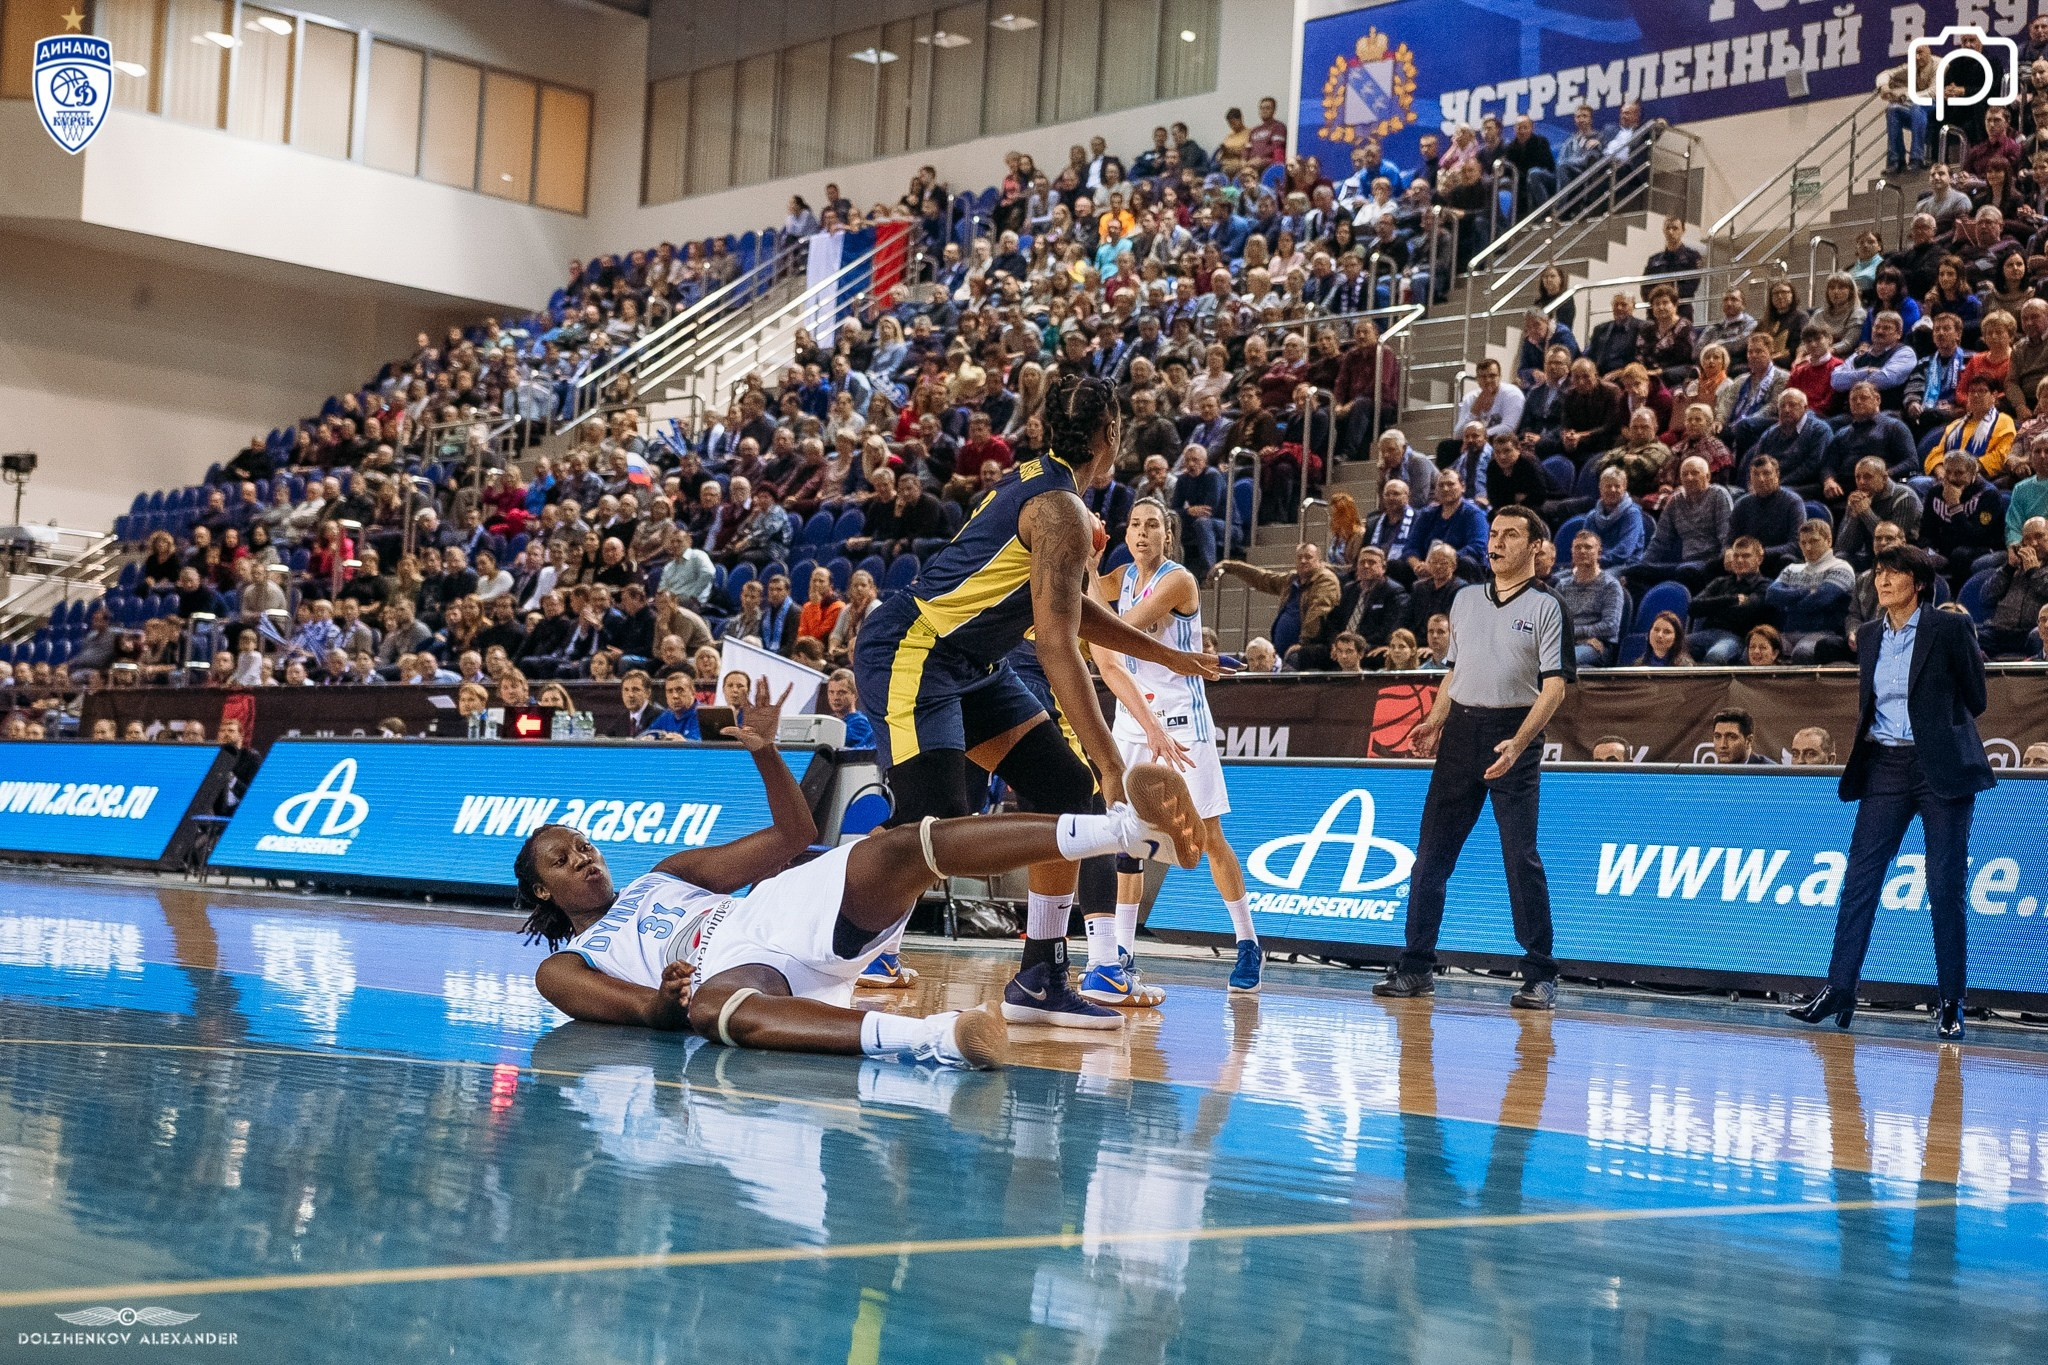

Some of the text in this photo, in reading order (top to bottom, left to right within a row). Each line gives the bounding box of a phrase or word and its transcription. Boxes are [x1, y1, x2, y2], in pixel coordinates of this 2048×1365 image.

[1440, 0, 2048, 137] УСТРЕМЛЕННЫЙ В БУ
[453, 794, 723, 846] wwwacase.ru
[1246, 891, 1401, 921] CADEMSERVICE
[1595, 842, 2048, 918] www.aae.
[637, 902, 687, 940] 31
